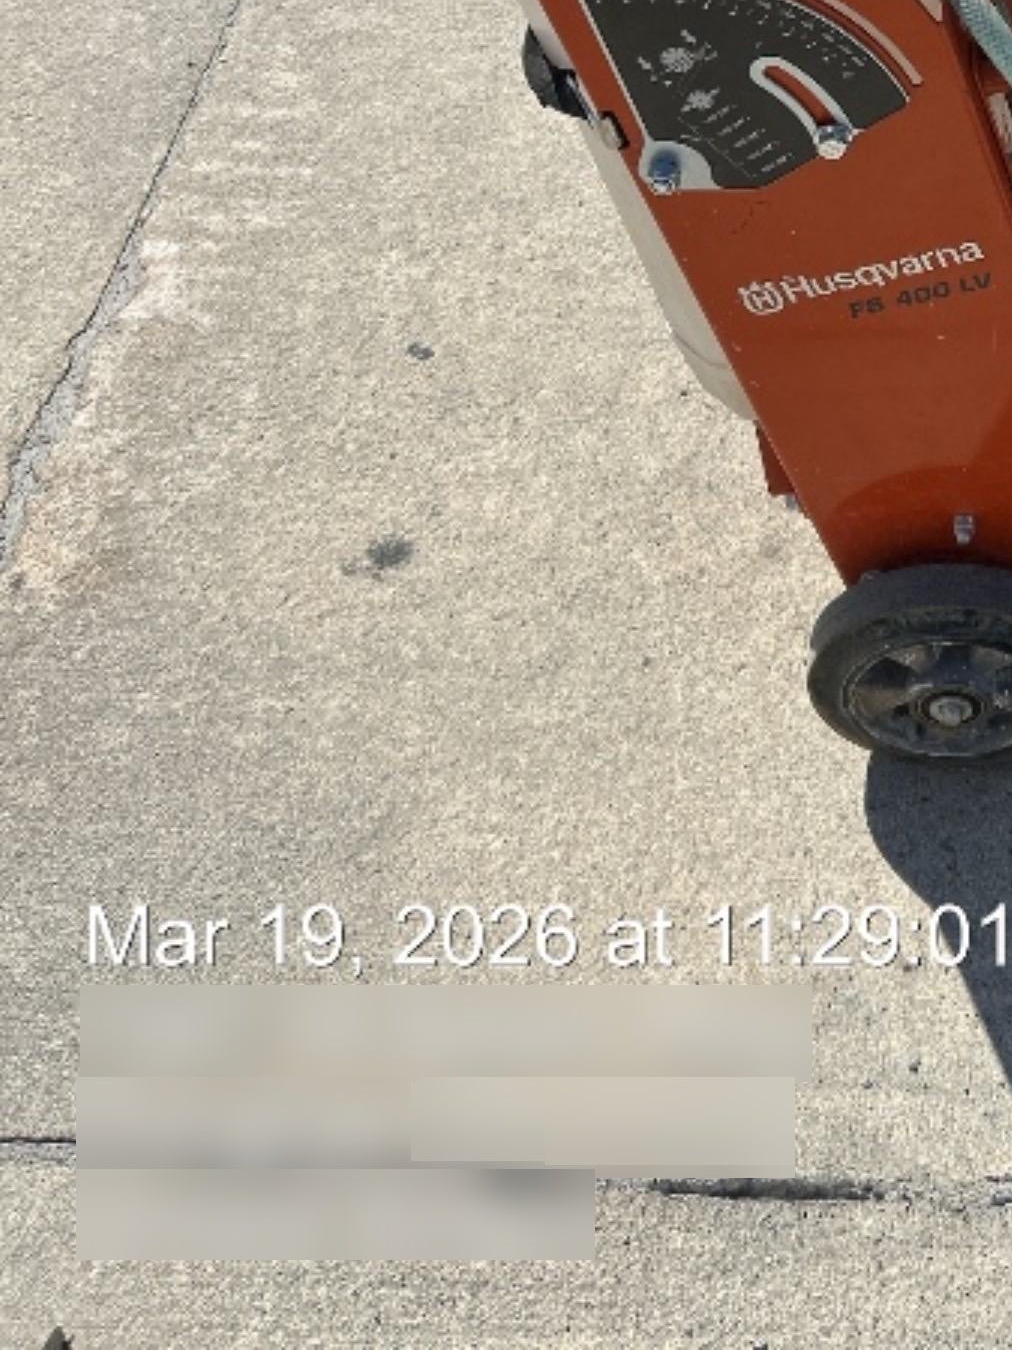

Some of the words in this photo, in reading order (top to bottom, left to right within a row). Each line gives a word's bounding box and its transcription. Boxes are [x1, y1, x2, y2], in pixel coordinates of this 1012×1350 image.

[780, 241, 985, 304] Husqvarna
[896, 281, 950, 307] 400
[960, 272, 992, 292] LV
